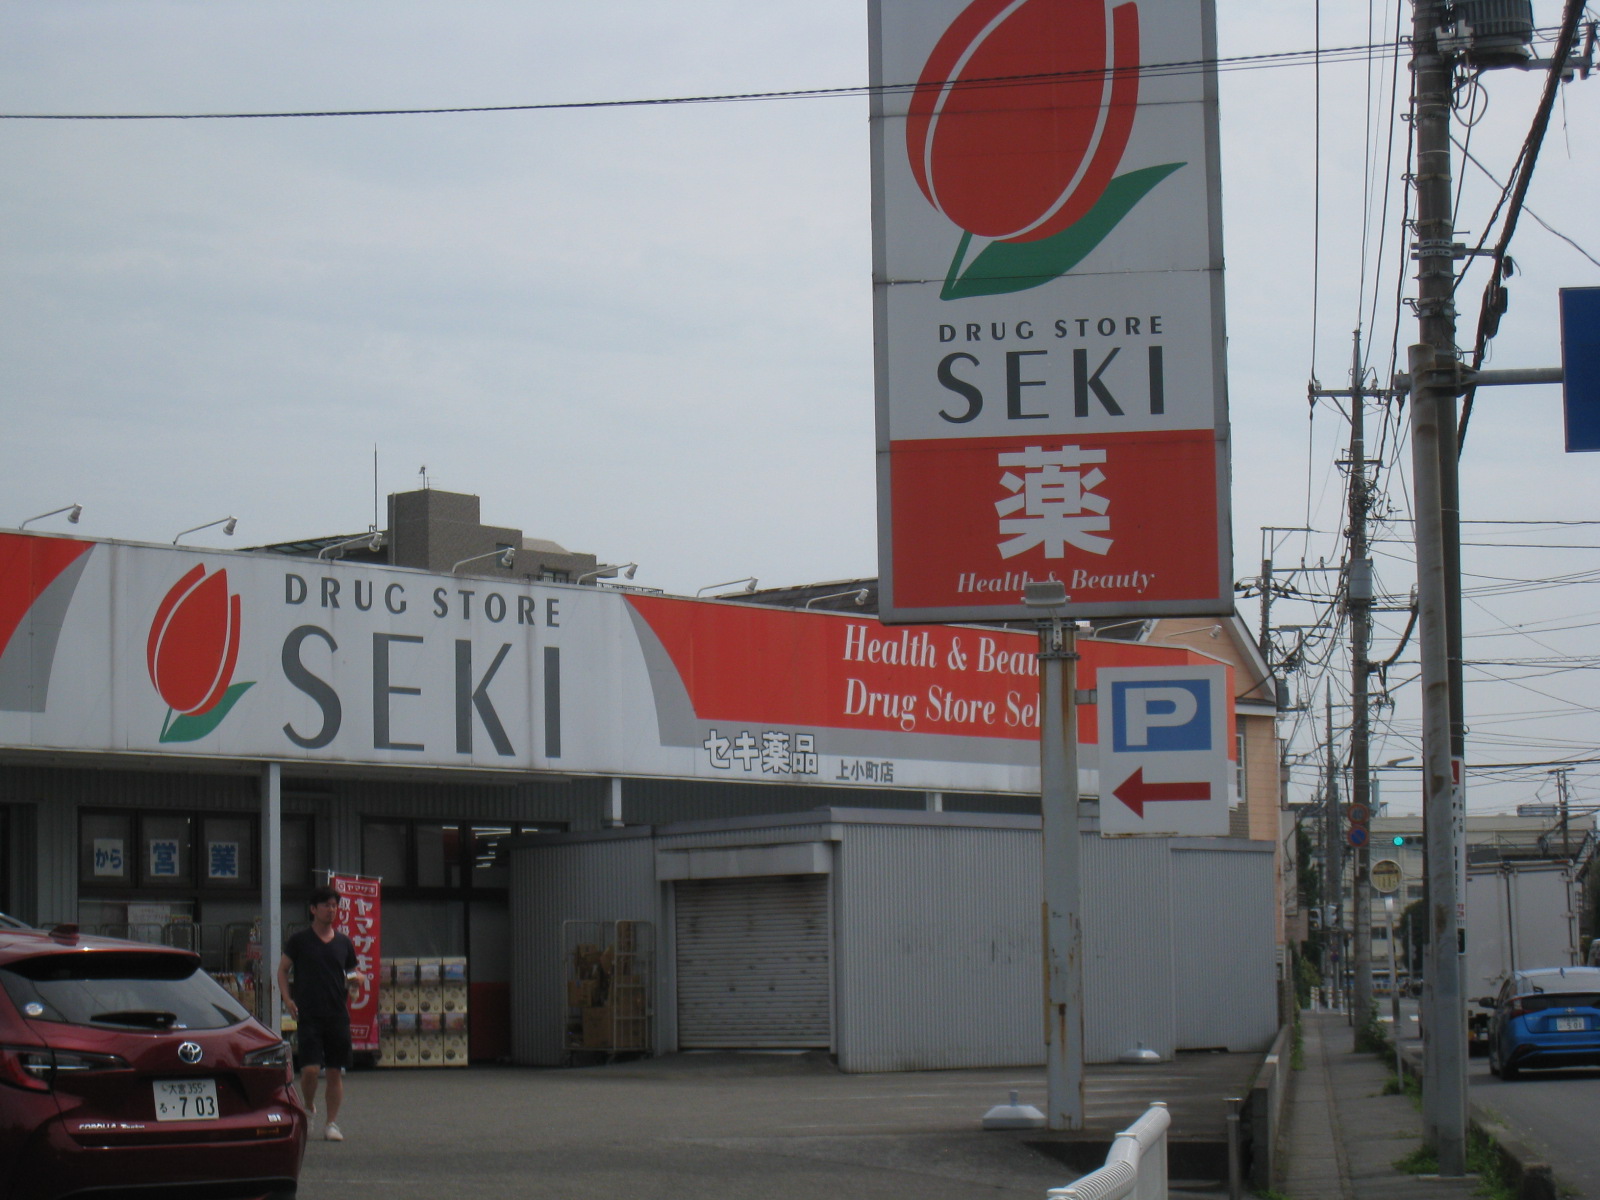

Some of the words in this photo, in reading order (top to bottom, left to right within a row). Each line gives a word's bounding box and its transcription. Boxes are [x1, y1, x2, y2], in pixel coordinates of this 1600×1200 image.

[939, 320, 1034, 343] DRUG
[1054, 315, 1163, 339] STORE
[936, 345, 1165, 424] SEKI
[994, 445, 1114, 560] 薬
[285, 573, 407, 615] DRUG
[433, 586, 561, 628] STORE
[957, 571, 1034, 593] Health
[1071, 569, 1155, 594] Beauty
[842, 624, 937, 668] Health
[947, 636, 968, 671] &
[976, 637, 1039, 676] Beau
[281, 624, 561, 758] SEKI
[843, 678, 917, 732] Drug
[926, 684, 996, 725] Store
[1125, 687, 1198, 746] P
[703, 728, 819, 775] セキ薬品
[835, 759, 894, 783] 上小町店
[95, 848, 122, 869] から
